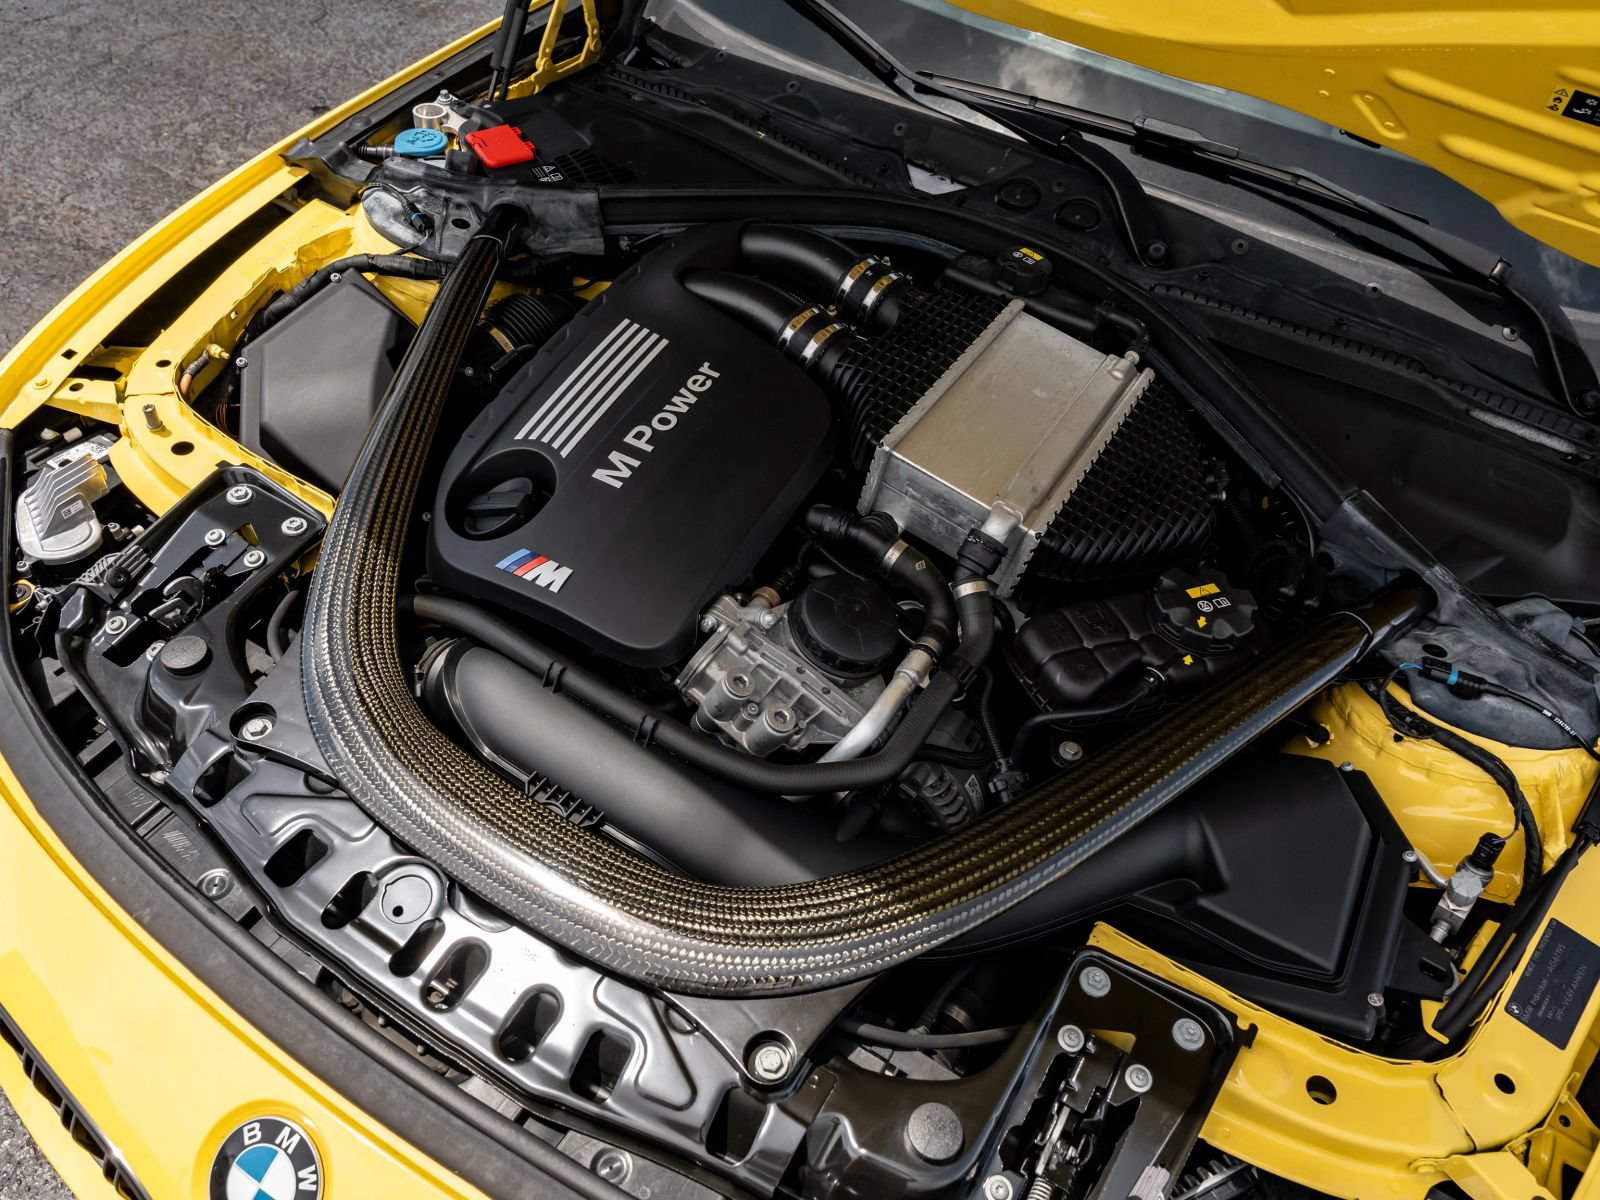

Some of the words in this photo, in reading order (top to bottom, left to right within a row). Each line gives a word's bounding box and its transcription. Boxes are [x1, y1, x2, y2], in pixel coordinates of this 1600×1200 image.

[592, 450, 642, 489] M
[623, 361, 720, 453] Power
[1521, 1004, 1534, 1022] BMW
[243, 1121, 318, 1191] BMW
